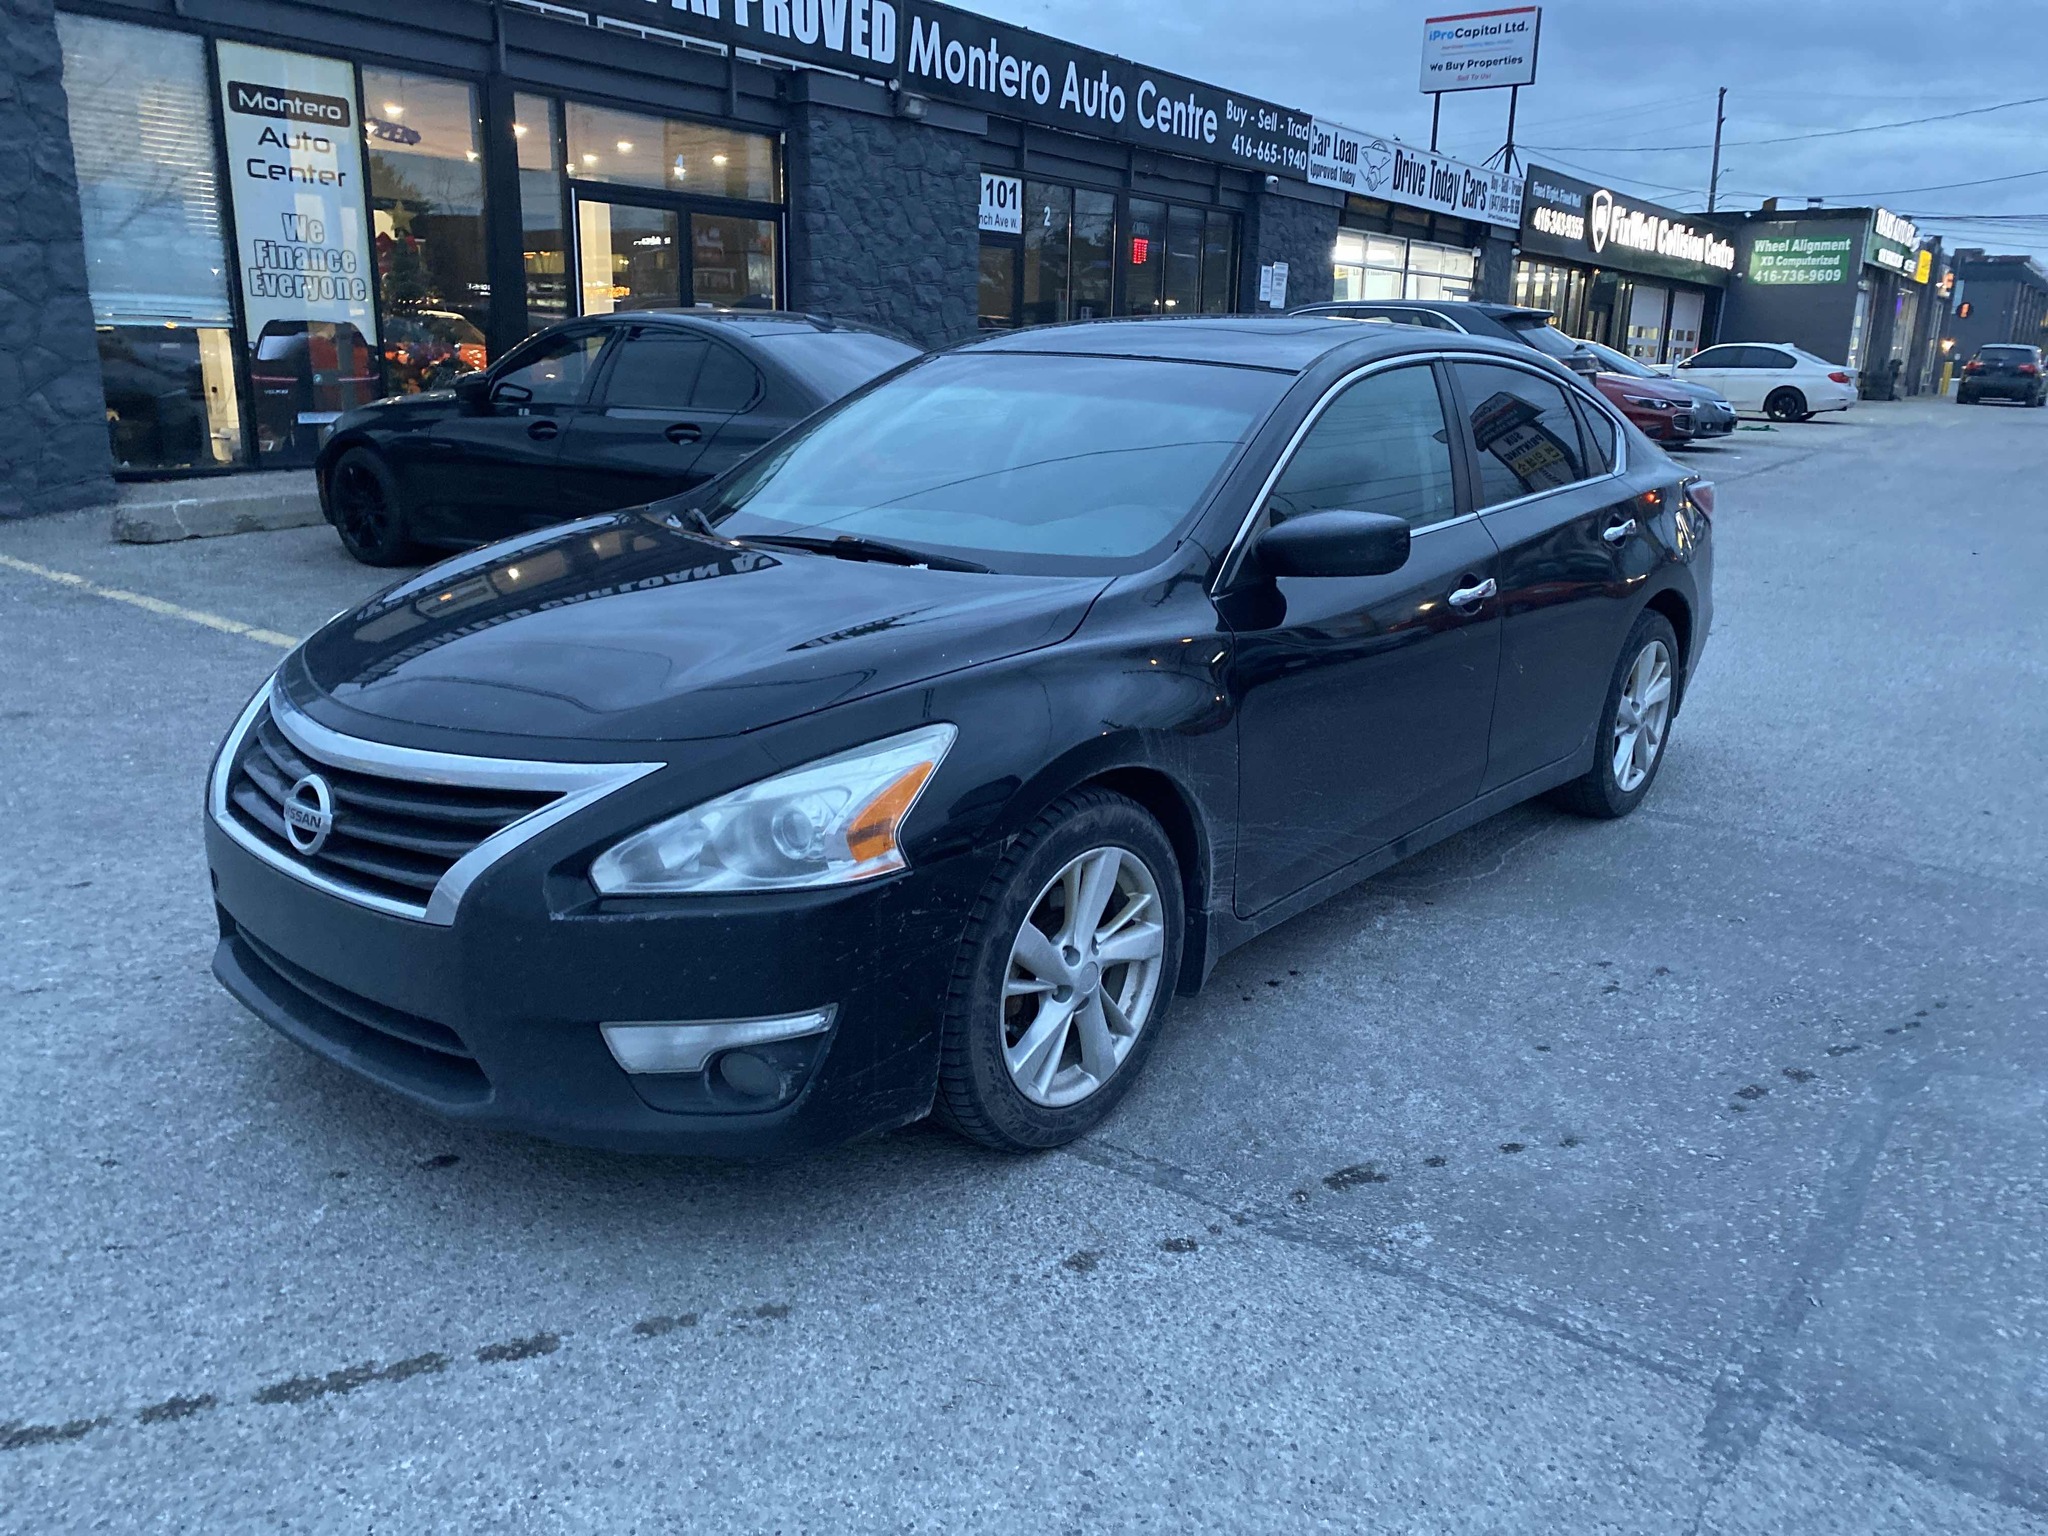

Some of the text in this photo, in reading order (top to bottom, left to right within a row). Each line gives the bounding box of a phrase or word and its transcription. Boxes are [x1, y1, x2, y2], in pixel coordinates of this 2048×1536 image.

[1429, 21, 1529, 41] iProCapital Ltd.
[1430, 55, 1523, 71] We Buy Properties
[908, 16, 1218, 144] Montero Auto Centre
[238, 89, 342, 120] Montero
[1226, 99, 1248, 128] Buy
[1257, 108, 1278, 132] Sell
[258, 126, 331, 153] Auto
[1231, 134, 1307, 171] 416-665-1940
[1312, 125, 1358, 165] Car Loan
[246, 158, 347, 187] Center
[1338, 165, 1357, 188] Today
[1393, 149, 1426, 197] Drive
[1428, 160, 1461, 211] Today
[1461, 169, 1488, 211] Cars
[986, 179, 1017, 210] 101
[281, 213, 325, 244] We
[994, 213, 1009, 228] Ave
[1043, 206, 1051, 227] 2
[254, 240, 357, 273] Finance
[1658, 219, 1704, 262] Collision
[1704, 233, 1735, 270] Centre
[1754, 238, 1851, 254] Wheel Alignment
[1754, 269, 1841, 282] 416-736-9609
[1760, 255, 1840, 268] XD Computerized
[248, 268, 367, 302] Everyone
